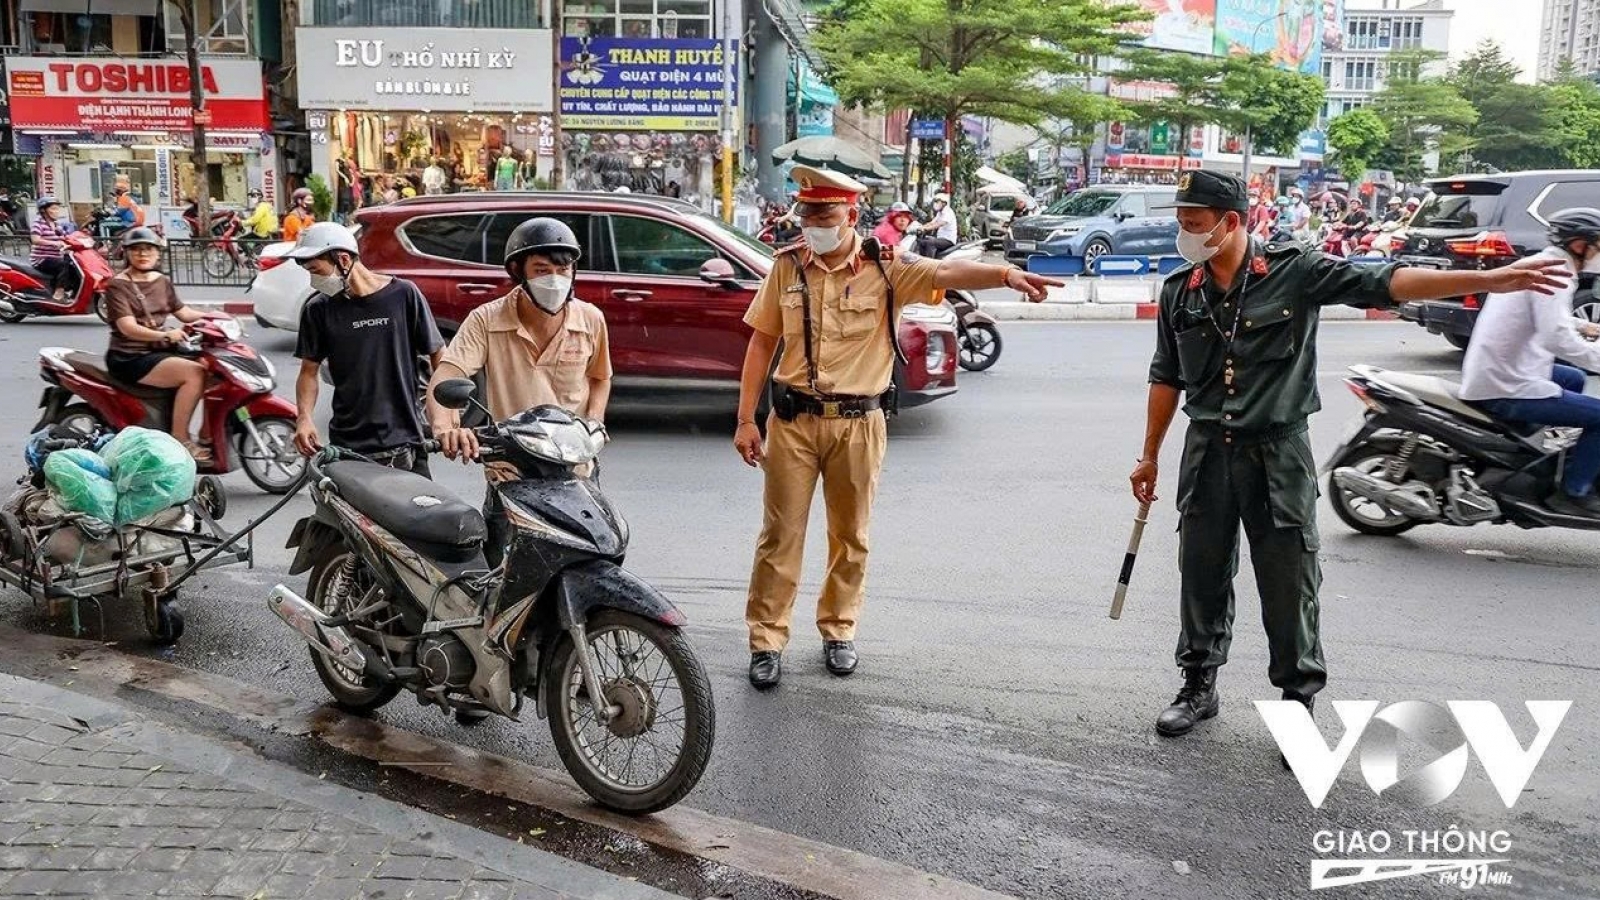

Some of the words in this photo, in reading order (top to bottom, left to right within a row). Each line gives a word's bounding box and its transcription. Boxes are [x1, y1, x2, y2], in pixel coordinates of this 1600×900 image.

[335, 39, 384, 67] EU
[487, 46, 516, 68] KỲ
[609, 48, 671, 64] THANH
[49, 63, 219, 93] TOSHIBA
[620, 70, 657, 84] QUẠT
[659, 69, 690, 85] ĐIỆN
[693, 71, 702, 82] 4
[672, 88, 688, 99] CÁC
[78, 102, 102, 117] ĐIỆN
[103, 104, 131, 117] LẠNH
[132, 104, 166, 117] THÀNH
[562, 102, 574, 111] UY
[309, 117, 326, 128] EU
[539, 135, 554, 147] EU
[353, 317, 389, 329] SPORT
